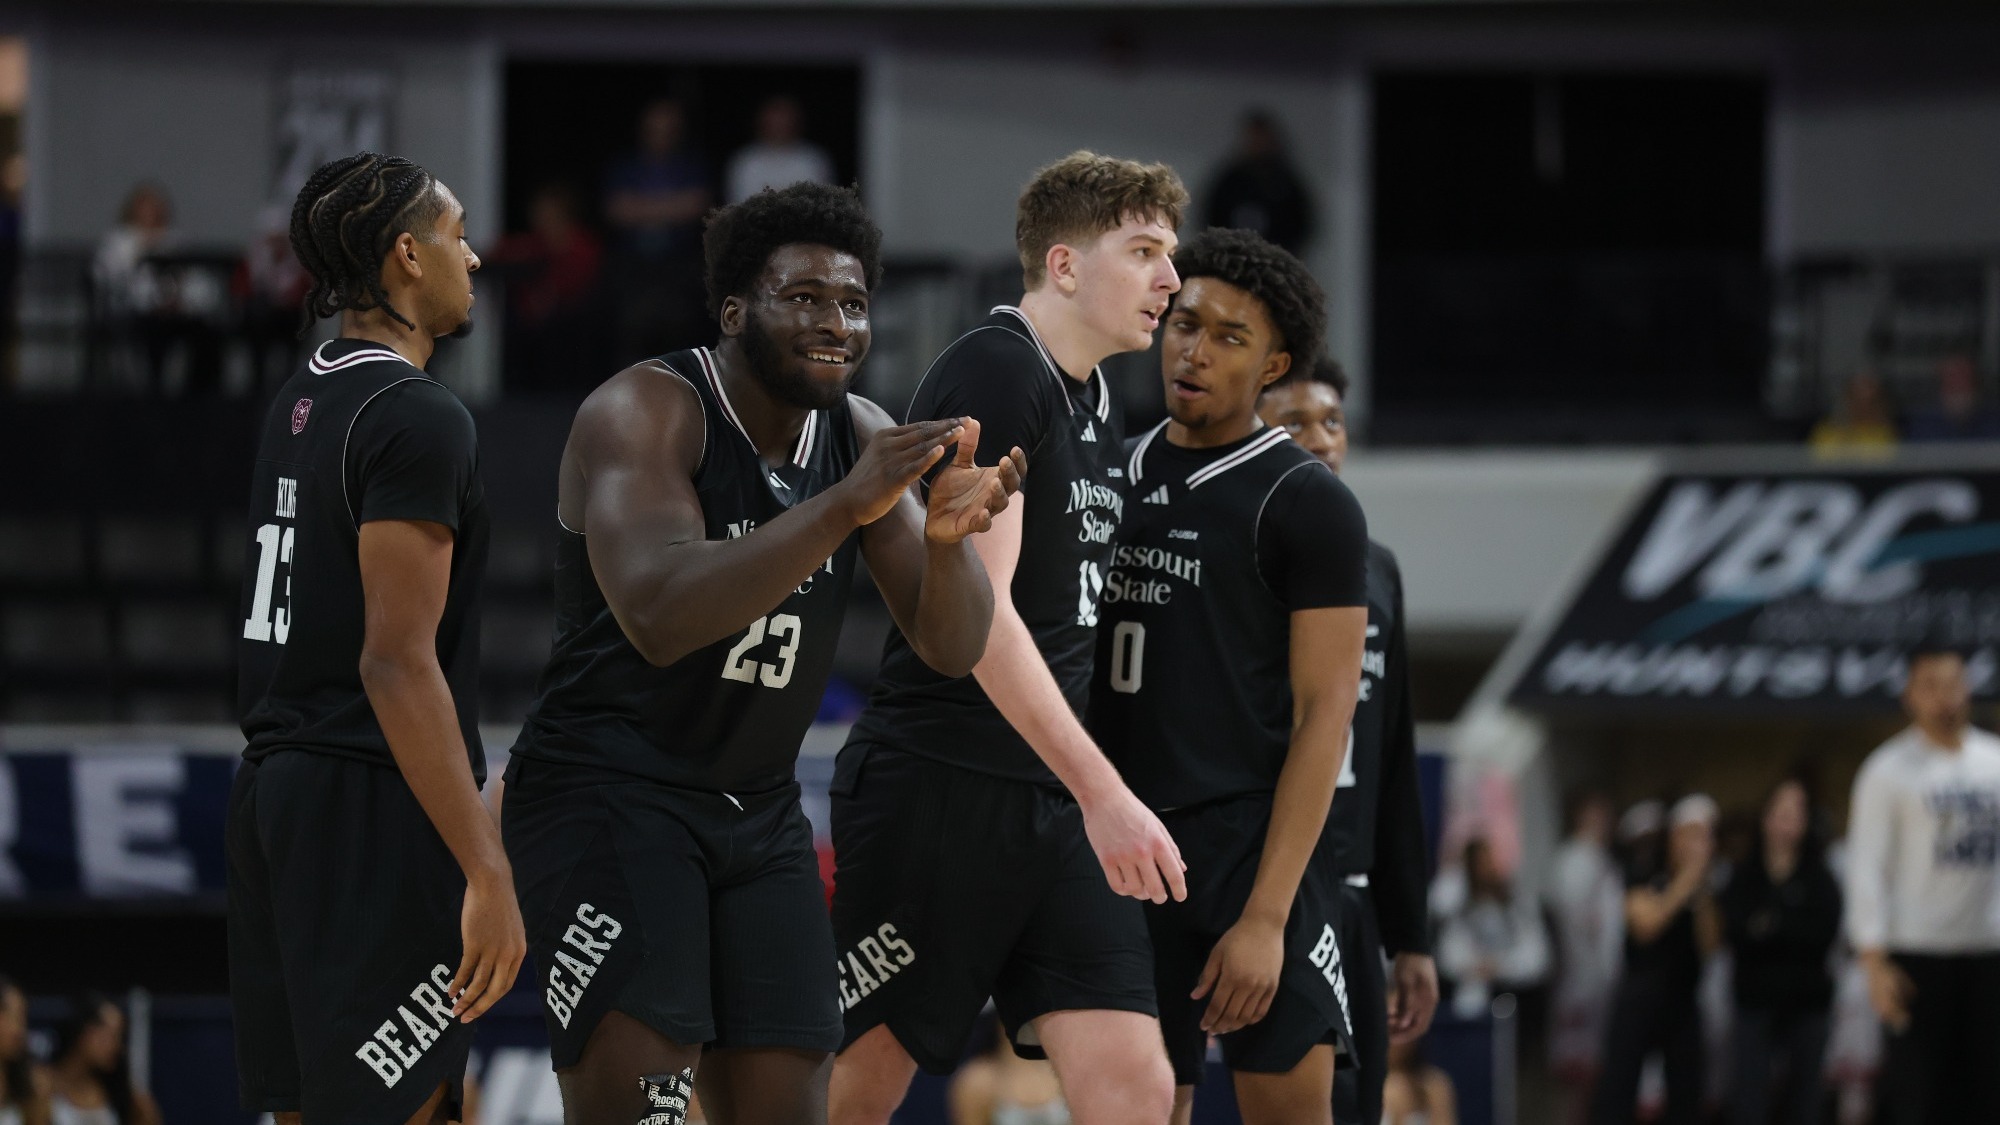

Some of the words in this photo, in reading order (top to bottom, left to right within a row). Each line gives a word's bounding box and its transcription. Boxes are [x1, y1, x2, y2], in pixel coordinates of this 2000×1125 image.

[276, 477, 297, 519] KING
[1110, 542, 1201, 587] issouri
[1622, 479, 1979, 601] VBC
[243, 523, 295, 645] 13
[1104, 571, 1171, 605] State
[721, 612, 802, 689] 23
[1110, 620, 1146, 694] 0
[545, 903, 623, 1031] BEARS
[838, 922, 916, 1015] EARS
